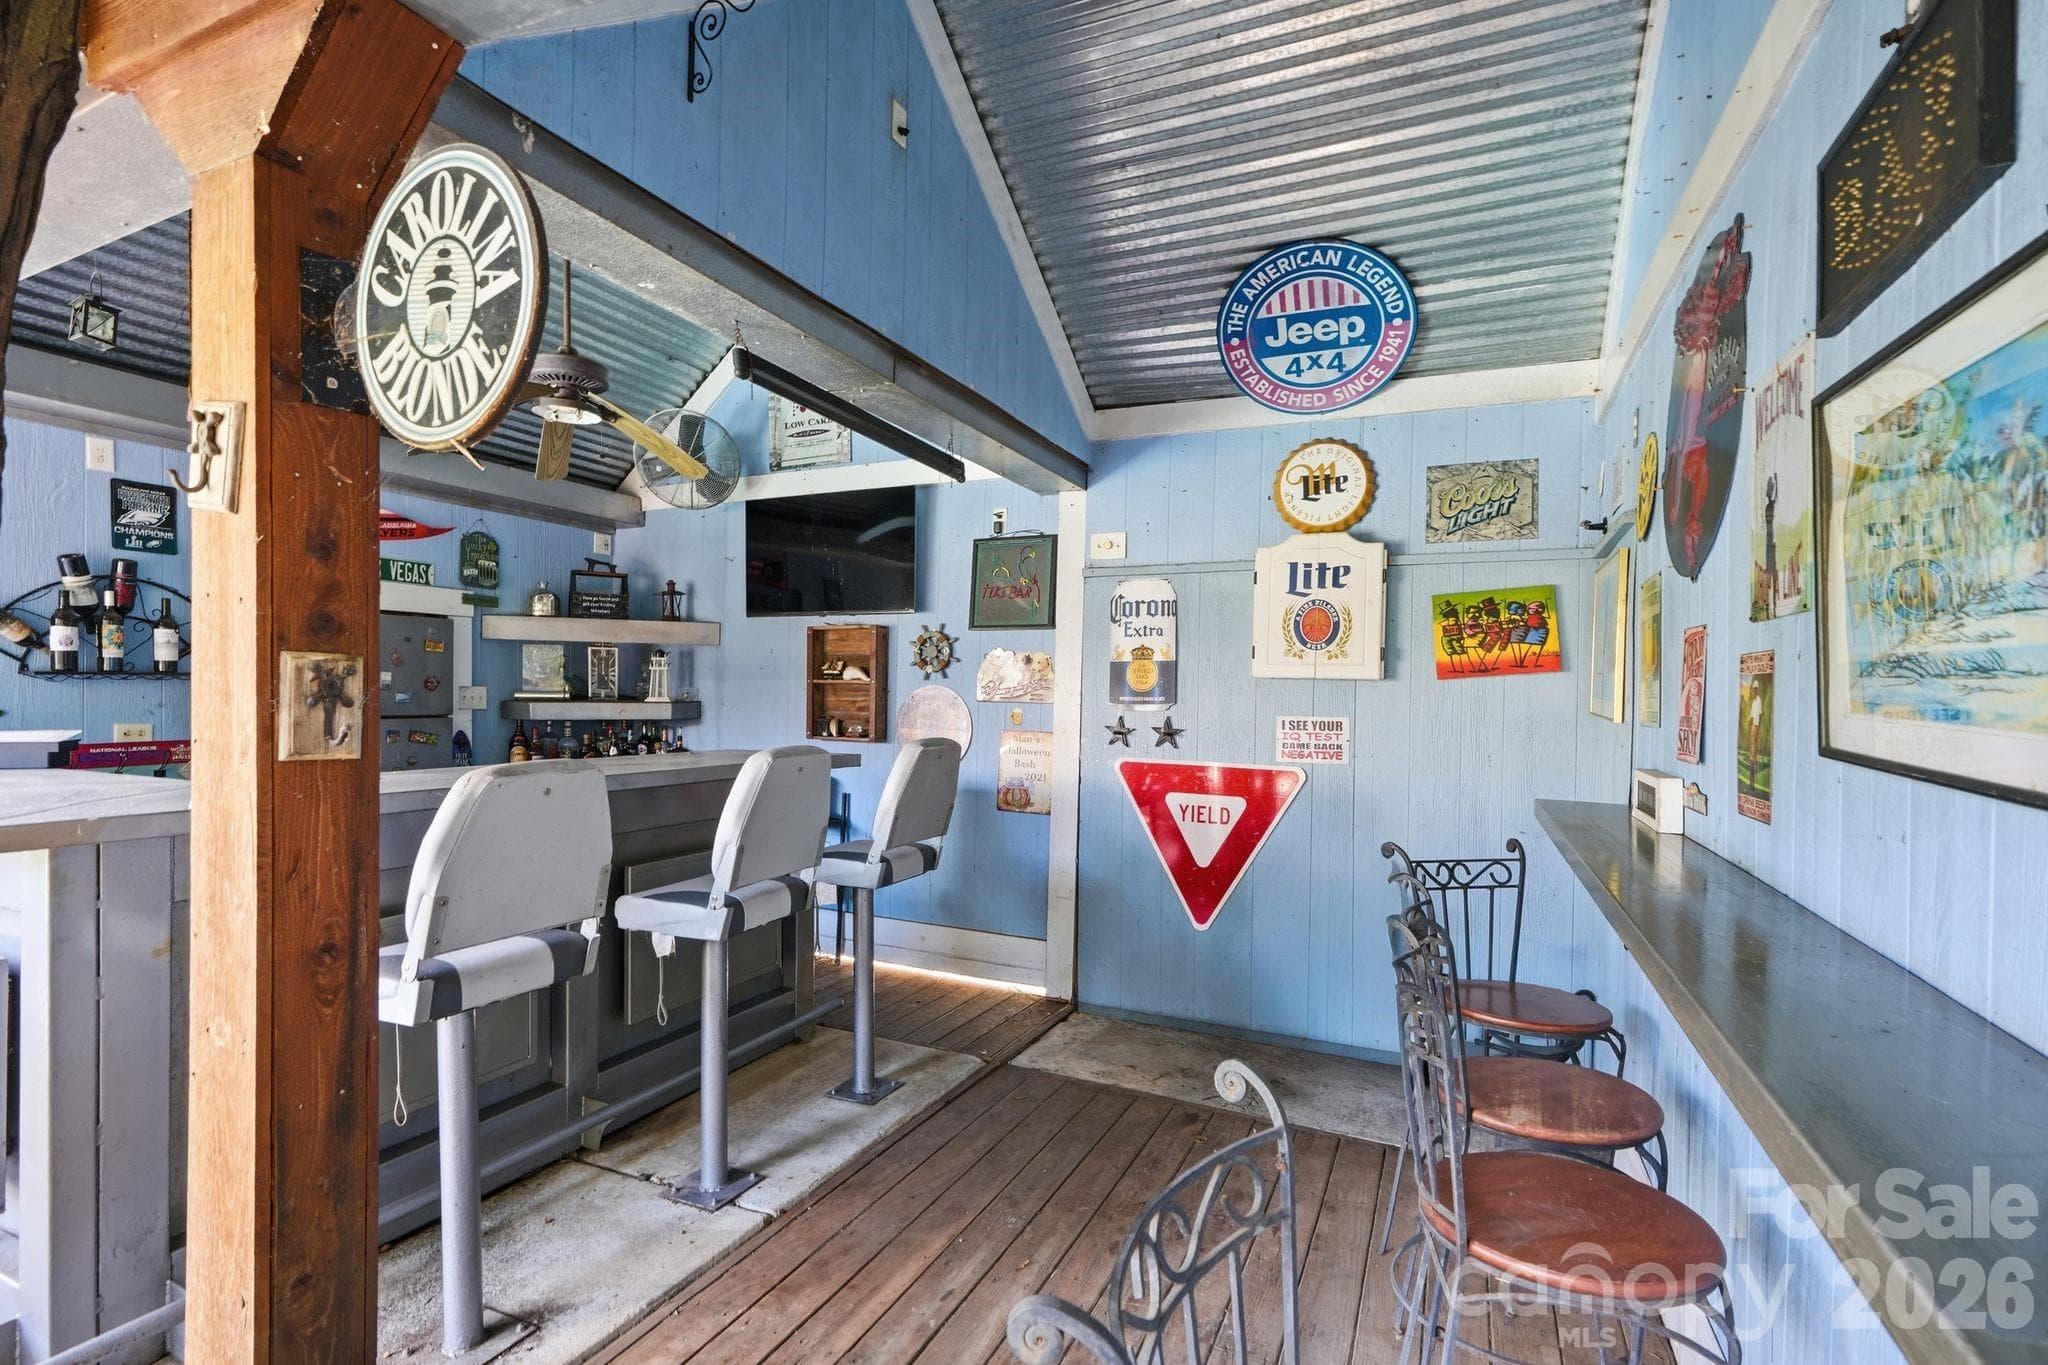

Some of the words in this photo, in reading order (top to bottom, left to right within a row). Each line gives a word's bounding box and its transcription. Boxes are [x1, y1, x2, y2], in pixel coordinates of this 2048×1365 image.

[371, 170, 521, 308] CAROLINA
[1227, 302, 1248, 334] THE
[1242, 250, 1342, 301] AMERICAN
[1347, 254, 1404, 314] LEGEND
[1265, 316, 1366, 349] Jeep
[372, 322, 503, 427] BLONDE
[1230, 348, 1326, 407] ESTABLISHED
[1333, 364, 1385, 404] SINCE
[1379, 330, 1406, 363] 1941
[784, 421, 805, 430] LOW
[1300, 448, 1322, 461] THE
[1327, 448, 1362, 488] ORIGINAL
[1300, 473, 1349, 502] Lite
[1438, 475, 1520, 518] Coors
[1328, 494, 1358, 520] LIGHT
[1446, 496, 1518, 535] LIGHT
[114, 525, 174, 540] CHAMPIONS
[390, 560, 427, 584] VEGAS
[1285, 562, 1351, 597] Lite
[1008, 585, 1033, 599] BAR
[1298, 600, 1314, 615] FINE
[1315, 599, 1339, 622] PILSNER
[1123, 621, 1164, 638] Extra
[1282, 720, 1286, 730] I
[1288, 720, 1308, 731] SEE
[1311, 720, 1343, 731] YOUR
[1282, 732, 1301, 742] IQ
[1306, 732, 1343, 741] TEST
[1281, 750, 1343, 760] NEGATIVE
[1282, 742, 1311, 750] CAME
[1014, 759, 1036, 768] Bash
[1025, 773, 1047, 782] 2021
[1179, 804, 1230, 825] YIELD
